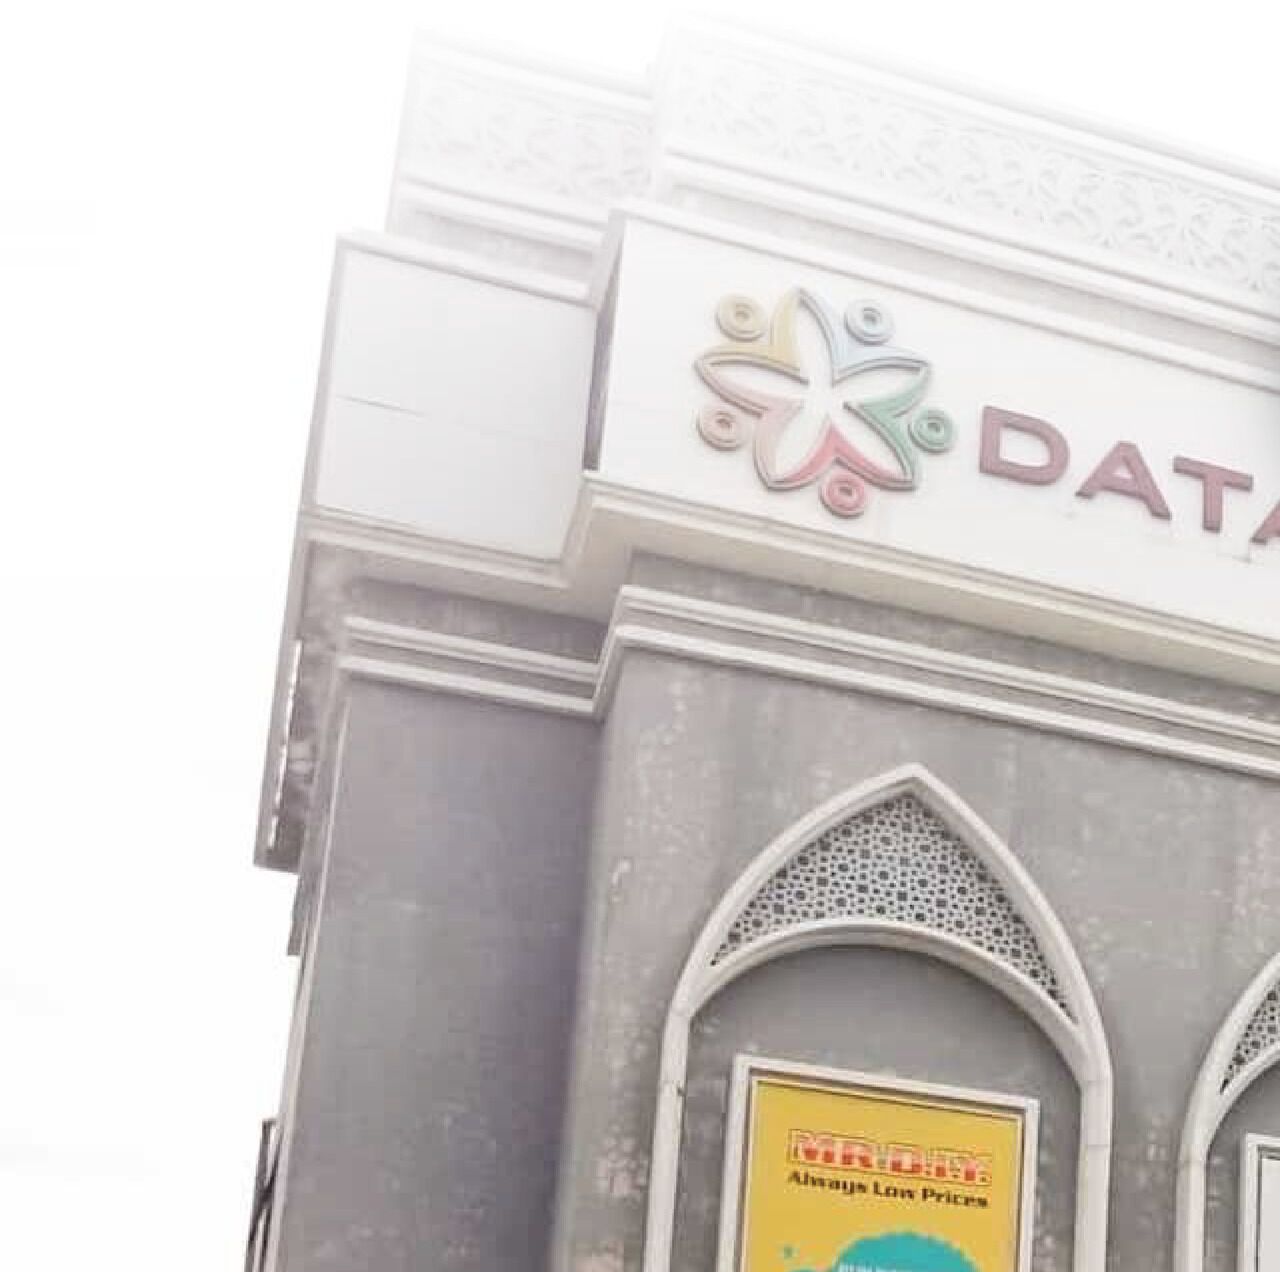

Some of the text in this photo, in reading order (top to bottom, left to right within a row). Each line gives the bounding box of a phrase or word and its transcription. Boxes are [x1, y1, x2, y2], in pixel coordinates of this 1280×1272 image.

[789, 1170, 988, 1208] Always Low Prices
